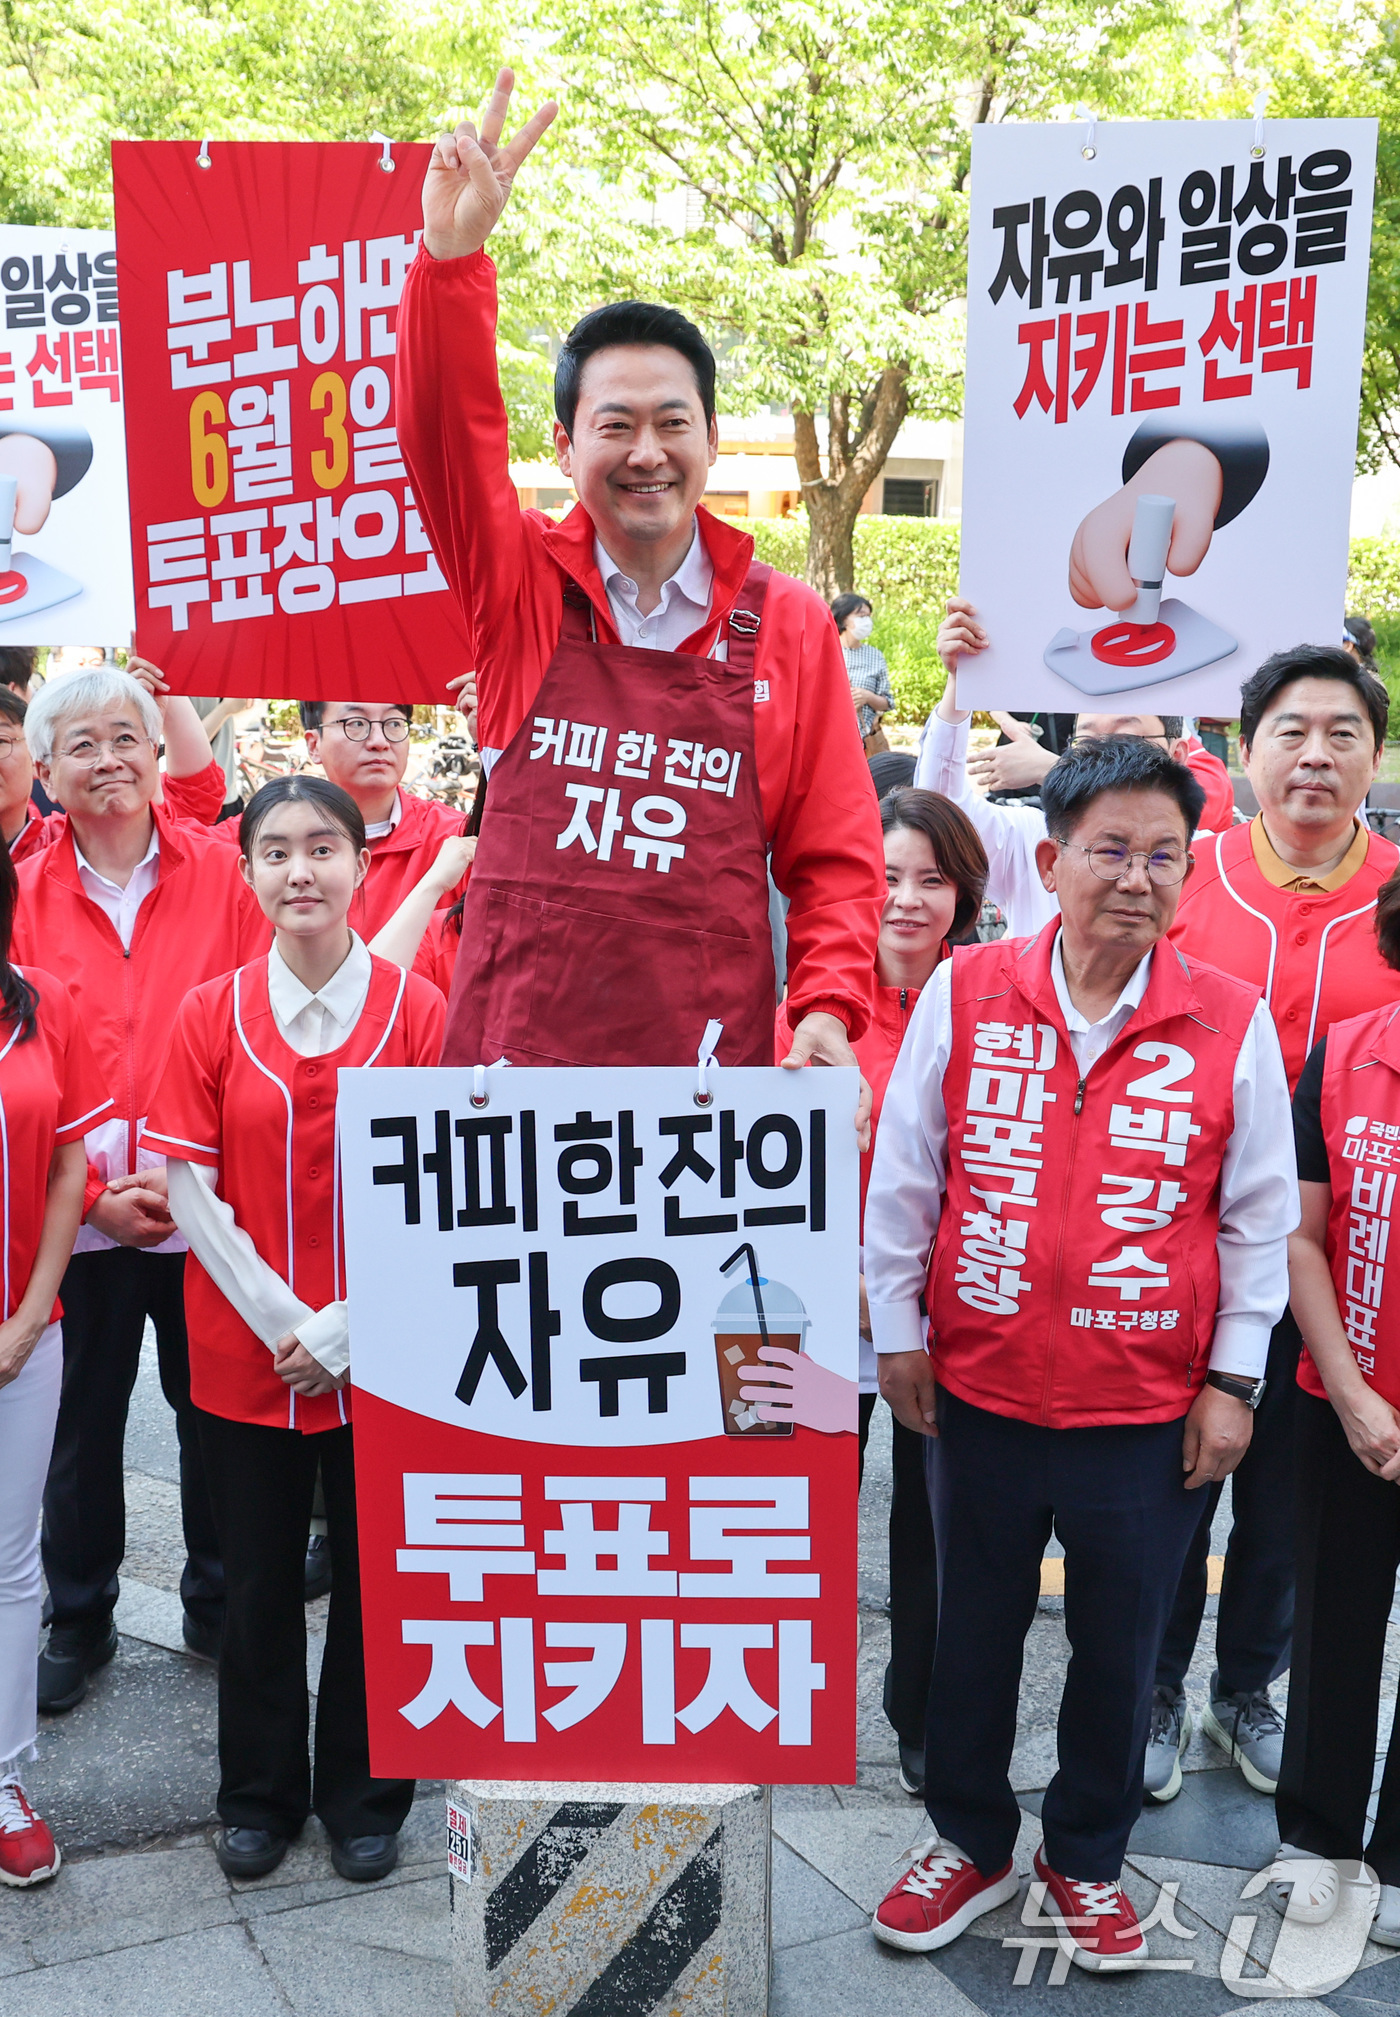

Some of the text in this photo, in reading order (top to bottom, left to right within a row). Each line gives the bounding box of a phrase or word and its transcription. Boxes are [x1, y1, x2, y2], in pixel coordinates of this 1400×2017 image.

[988, 148, 1353, 310] 자유와 일상을
[26, 328, 120, 409] 선택
[1013, 274, 1318, 425] 지키는 선택
[189, 365, 408, 508] 6월 3일
[529, 716, 742, 798] 커피 한 잔의
[556, 783, 688, 874] 자유
[369, 1108, 827, 1237] 커피 한 잔의
[1087, 1040, 1202, 1300] 2 박강수
[1341, 1137, 1400, 1167] 마포
[1369, 1120, 1400, 1142] 국민
[1070, 1306, 1181, 1331] 마포구청장
[1344, 1166, 1398, 1351] 비례대표
[452, 1251, 687, 1417] 자유
[395, 1472, 822, 1603] 투표로
[398, 1616, 826, 1746] 지키자
